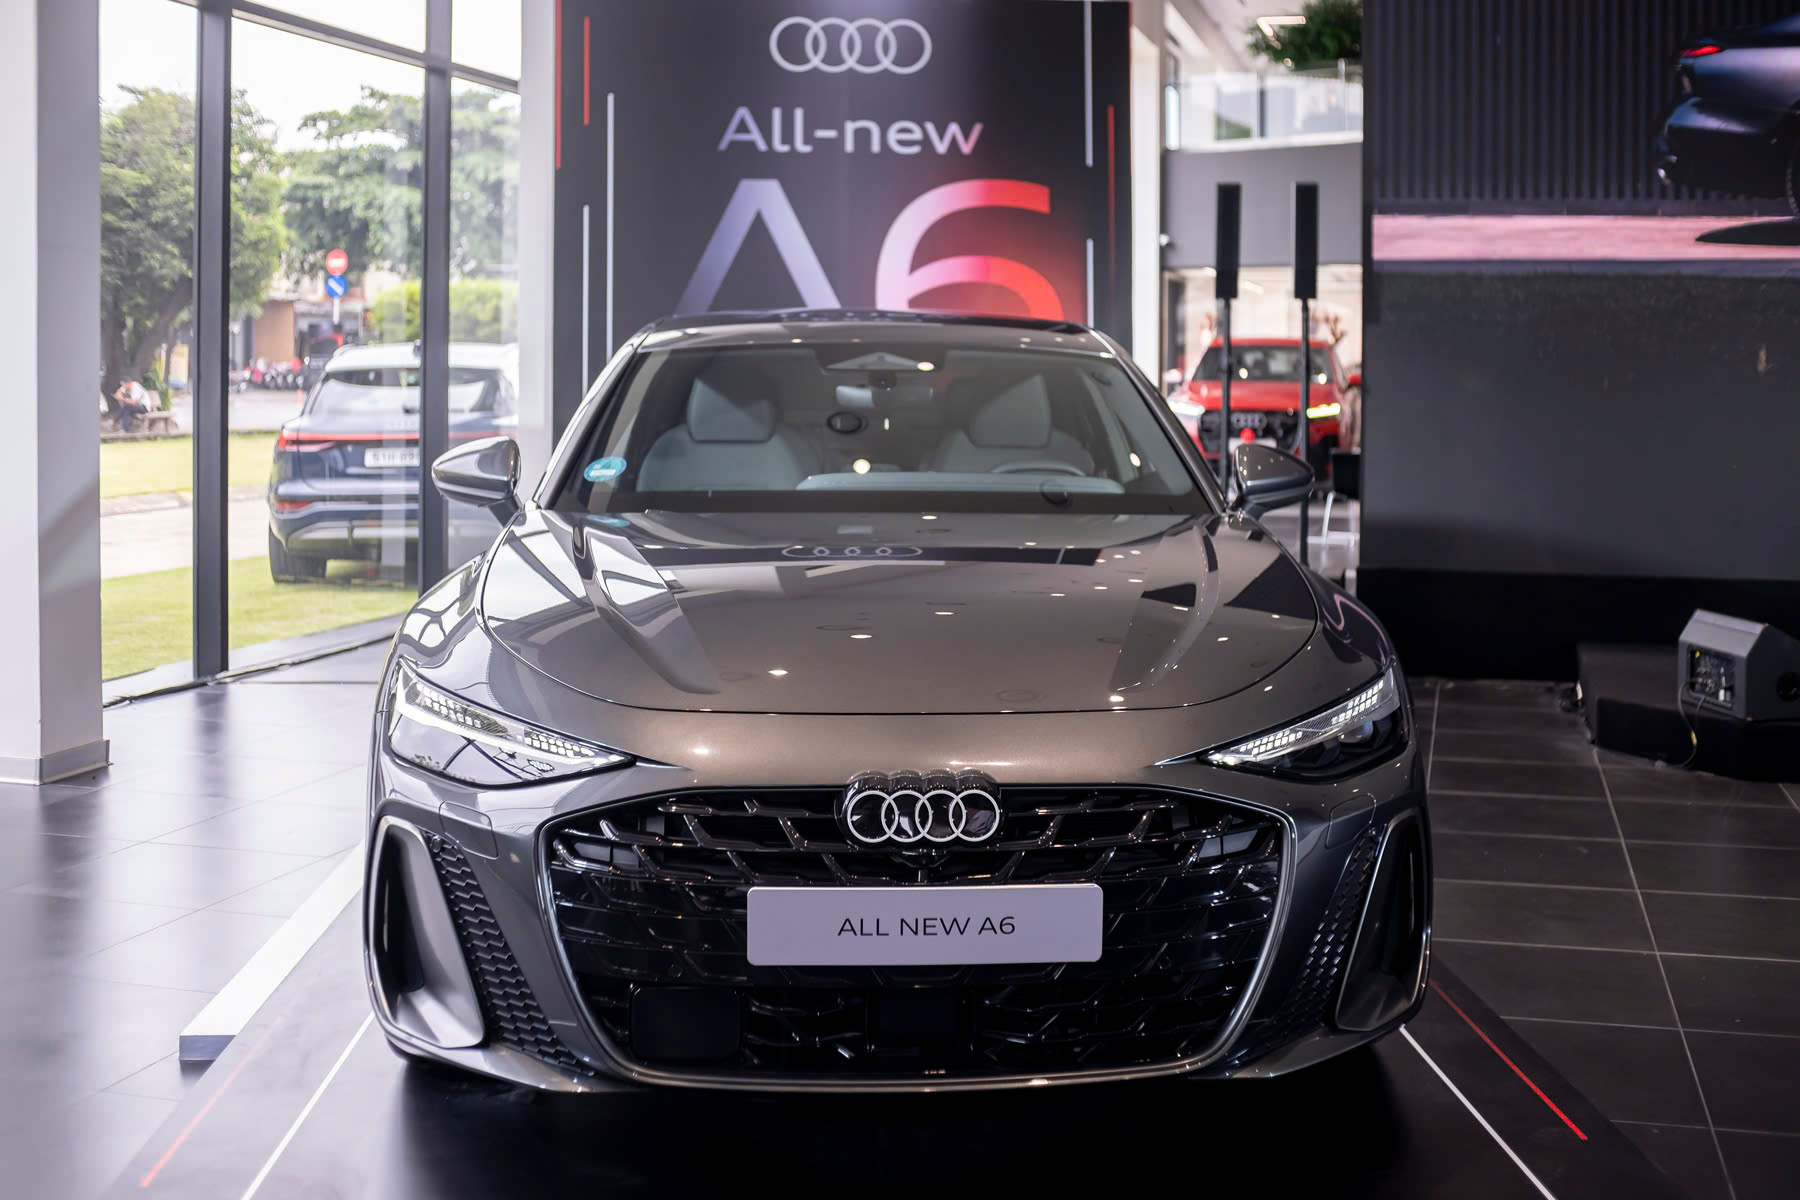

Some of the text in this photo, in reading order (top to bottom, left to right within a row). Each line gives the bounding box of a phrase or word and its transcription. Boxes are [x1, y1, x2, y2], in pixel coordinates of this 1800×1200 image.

[718, 106, 983, 155] All-new
[673, 178, 1065, 321] A6
[837, 915, 1016, 937] ALL NEW A6
